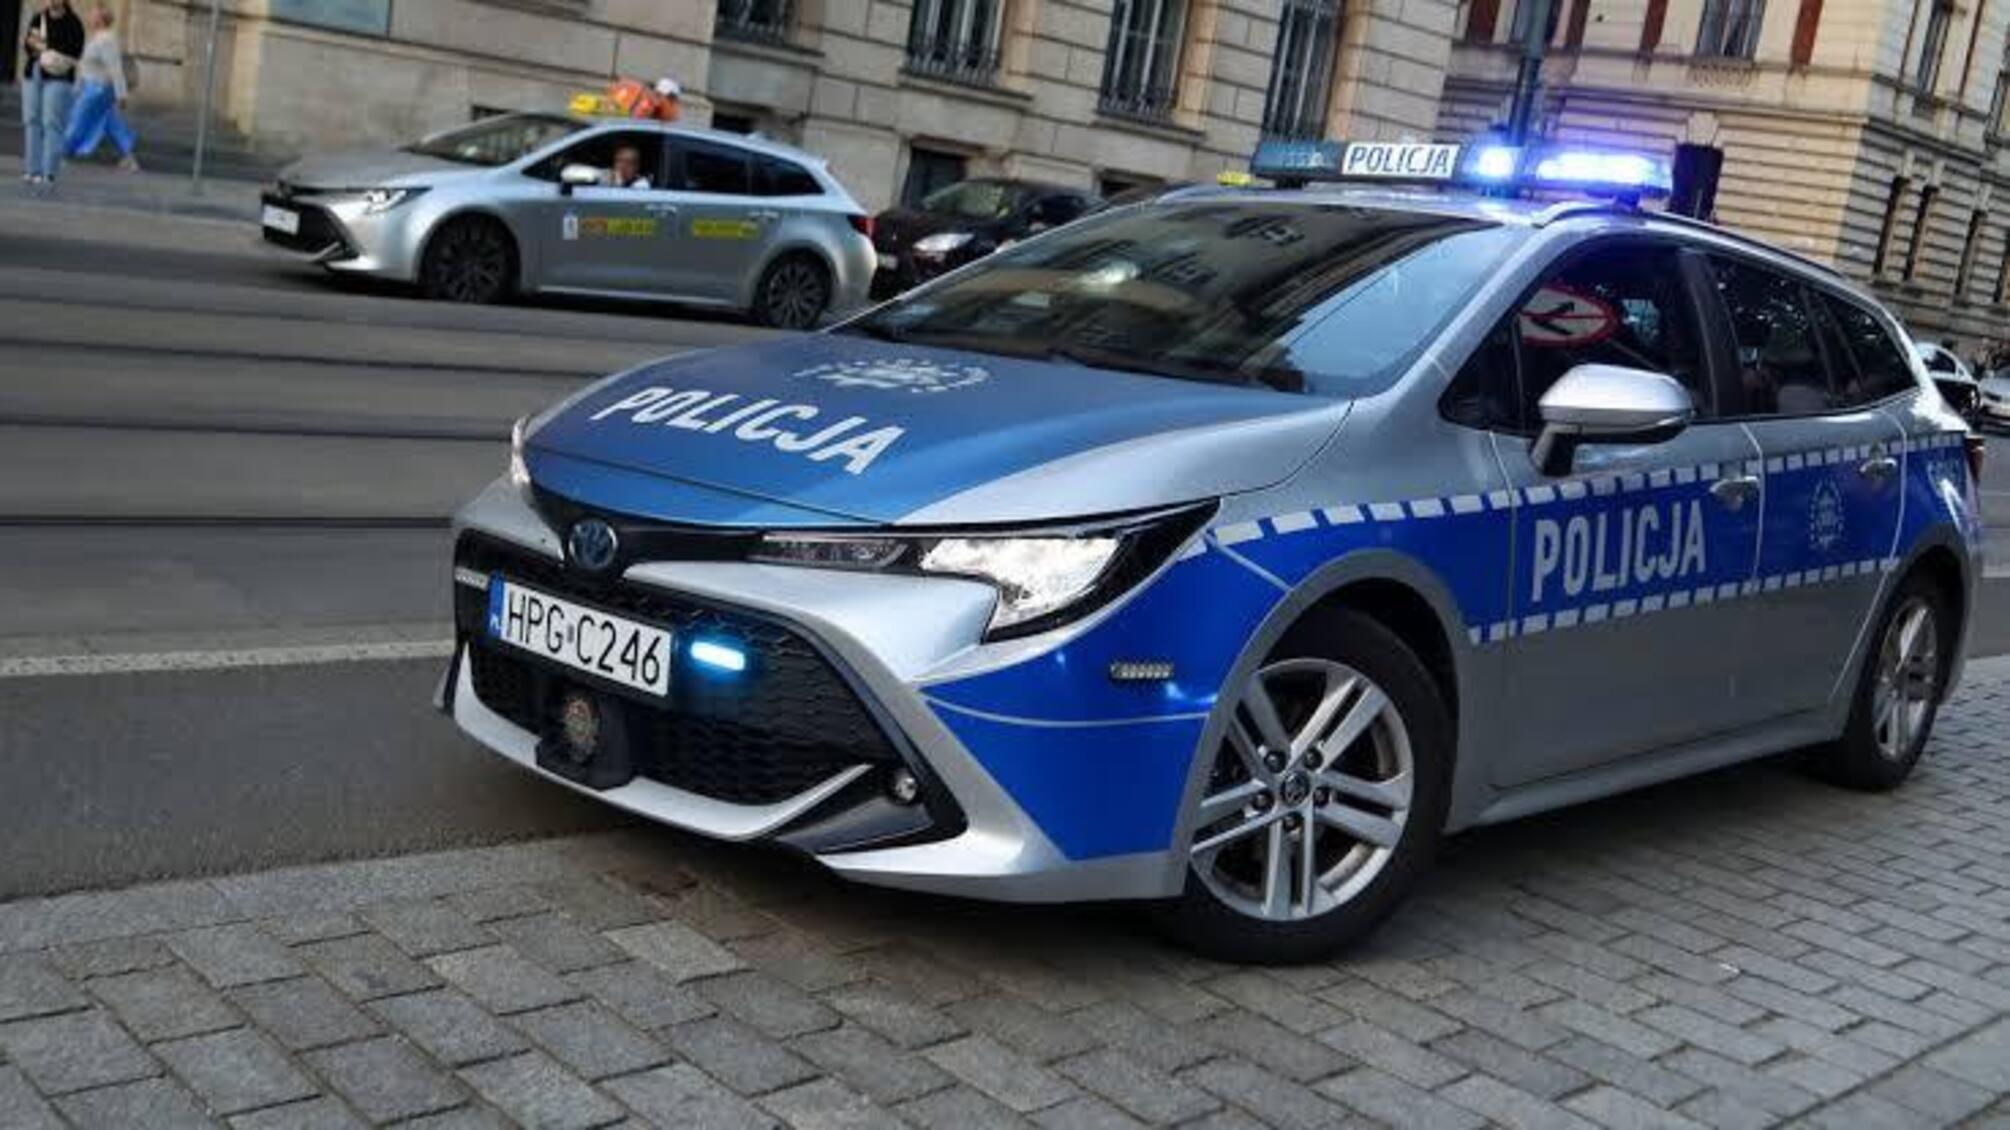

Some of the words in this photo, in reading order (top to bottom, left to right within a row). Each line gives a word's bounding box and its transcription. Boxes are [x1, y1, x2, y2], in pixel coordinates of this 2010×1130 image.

[1347, 146, 1451, 173] POLICJA
[590, 386, 906, 475] POLICJA
[1532, 500, 1706, 601] POLICJA
[506, 590, 565, 655] HPG
[576, 614, 662, 686] C246
